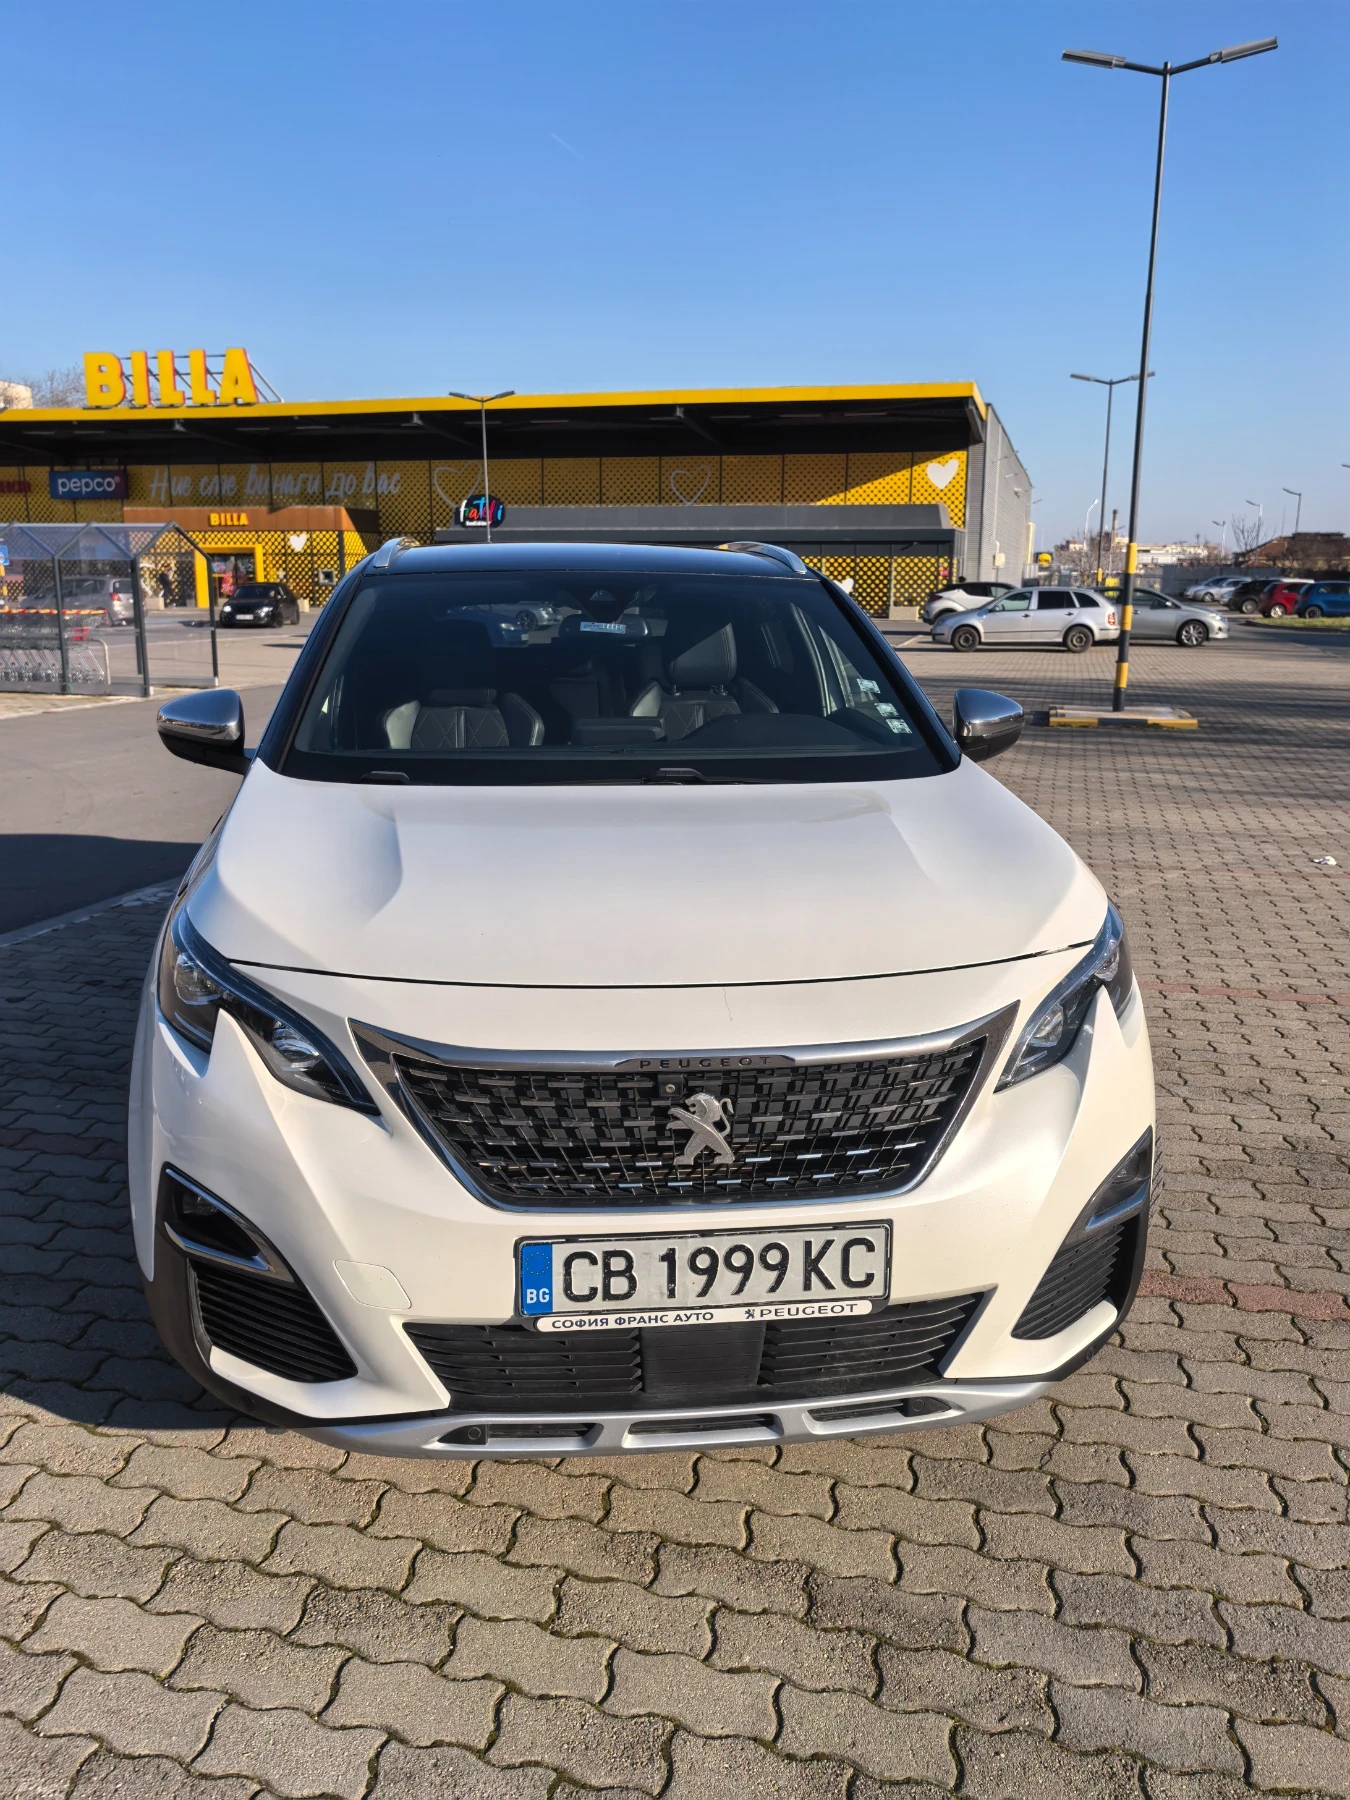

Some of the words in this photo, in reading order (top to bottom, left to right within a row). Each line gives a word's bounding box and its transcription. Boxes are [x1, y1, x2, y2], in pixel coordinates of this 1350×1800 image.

[84, 347, 259, 407] BILLA
[57, 477, 116, 495] pepco
[150, 465, 193, 501] Ние
[325, 472, 357, 499] до
[209, 512, 249, 526] BILLA
[640, 1056, 773, 1069] PEUGEOT
[563, 1250, 638, 1303] CB
[658, 1242, 790, 1299] 1999
[803, 1237, 876, 1293] KC
[526, 1288, 550, 1304] BG
[760, 1303, 858, 1319] PEUGEOT
[551, 1318, 609, 1330] СОФИЯ
[613, 1314, 670, 1327] ФРАНС
[672, 1311, 715, 1323] АУТО
